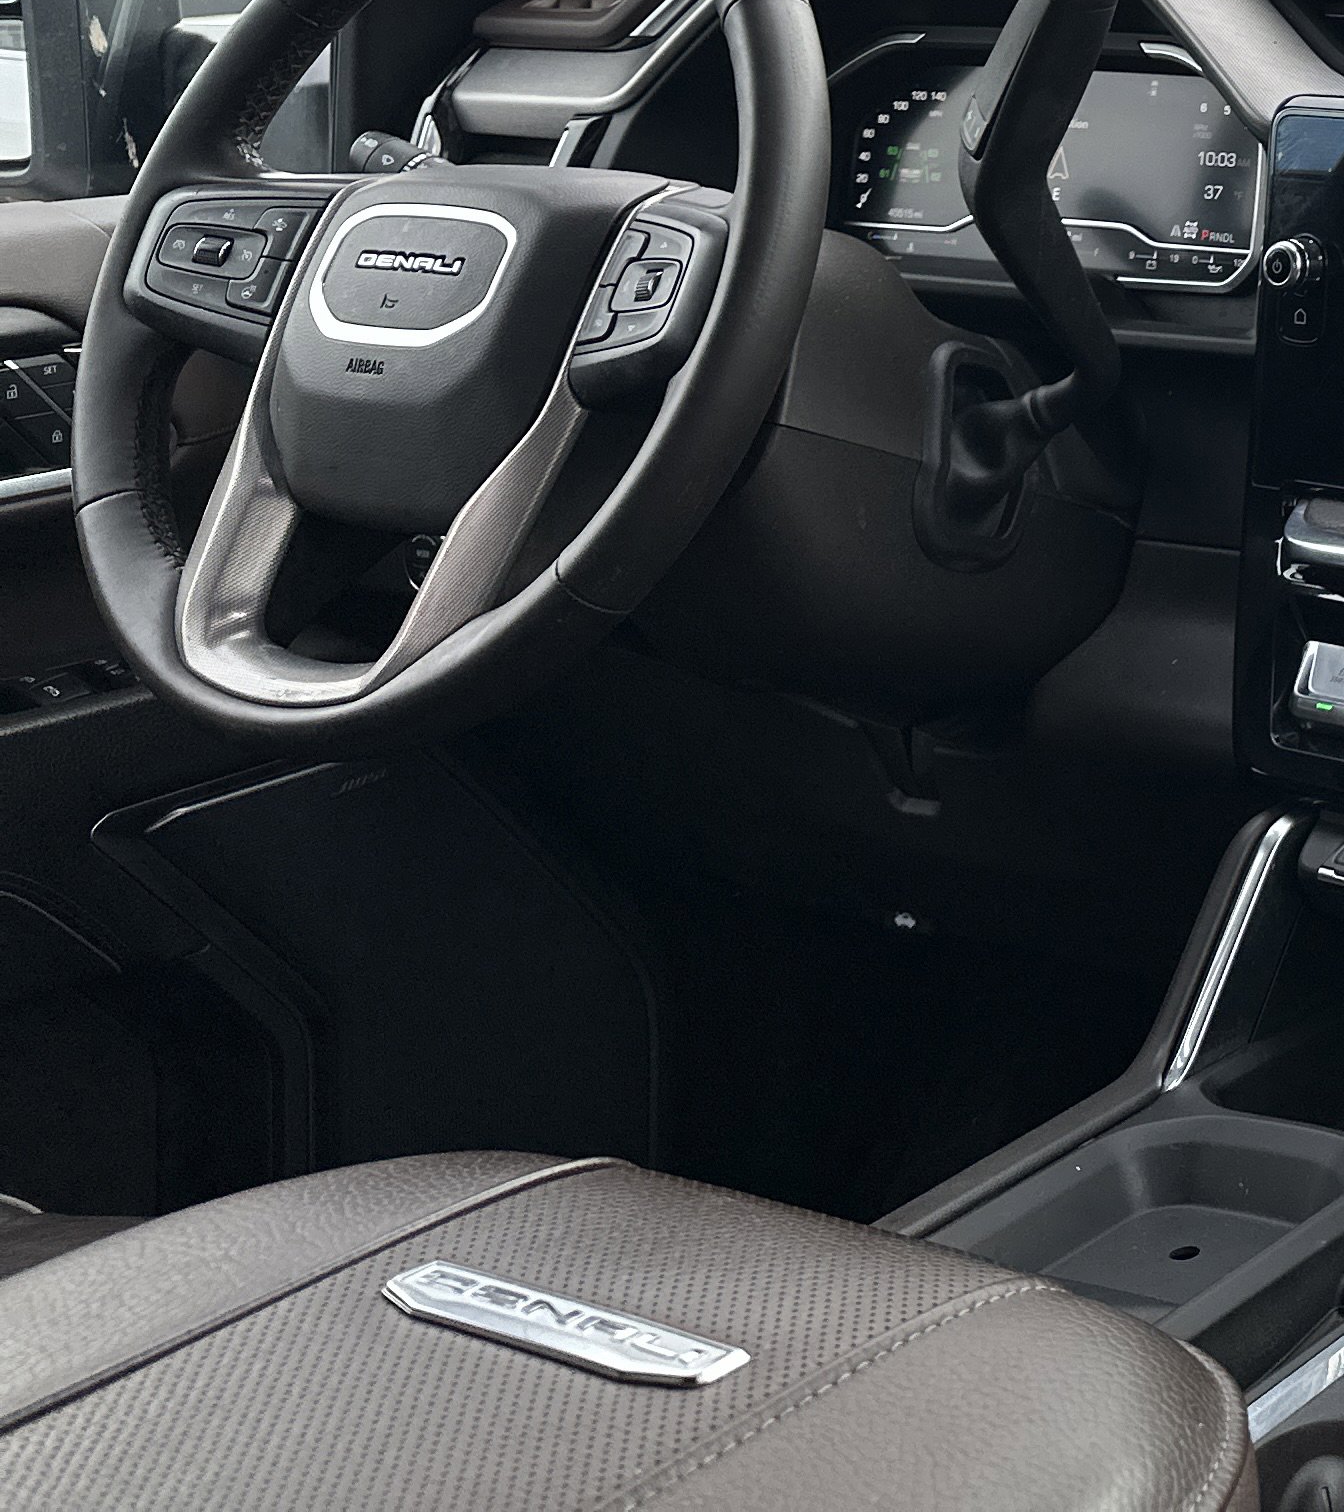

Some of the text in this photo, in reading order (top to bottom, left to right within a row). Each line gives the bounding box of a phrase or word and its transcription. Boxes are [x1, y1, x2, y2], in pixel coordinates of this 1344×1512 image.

[1197, 151, 1237, 168] 10:03
[1203, 185, 1224, 200] 37
[356, 251, 464, 275] DENALI
[345, 357, 385, 375] AIRBAG
